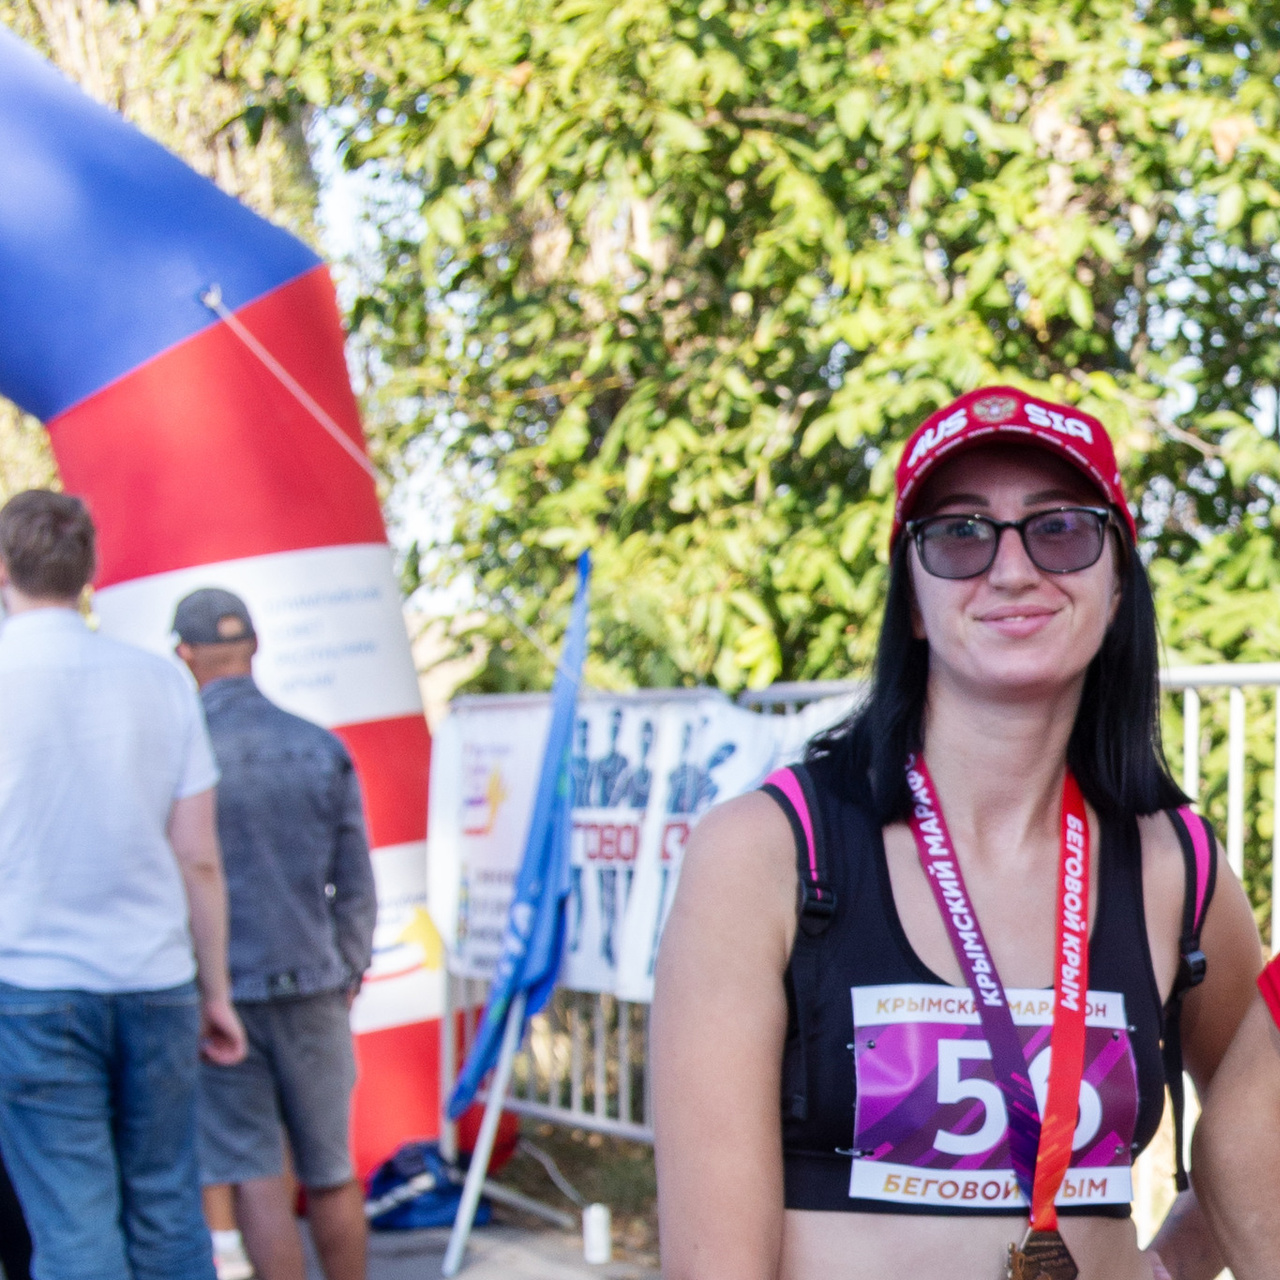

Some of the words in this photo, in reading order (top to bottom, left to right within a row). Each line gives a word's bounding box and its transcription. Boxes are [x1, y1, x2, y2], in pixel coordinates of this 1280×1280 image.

[1064, 812, 1087, 933] БЕГОВОЙ
[927, 861, 999, 1008] КРЫМСКИЙ
[1060, 931, 1082, 1012] КРЫМ
[932, 1038, 1103, 1156] 56
[882, 1173, 1020, 1201] БЕГОВОЙ
